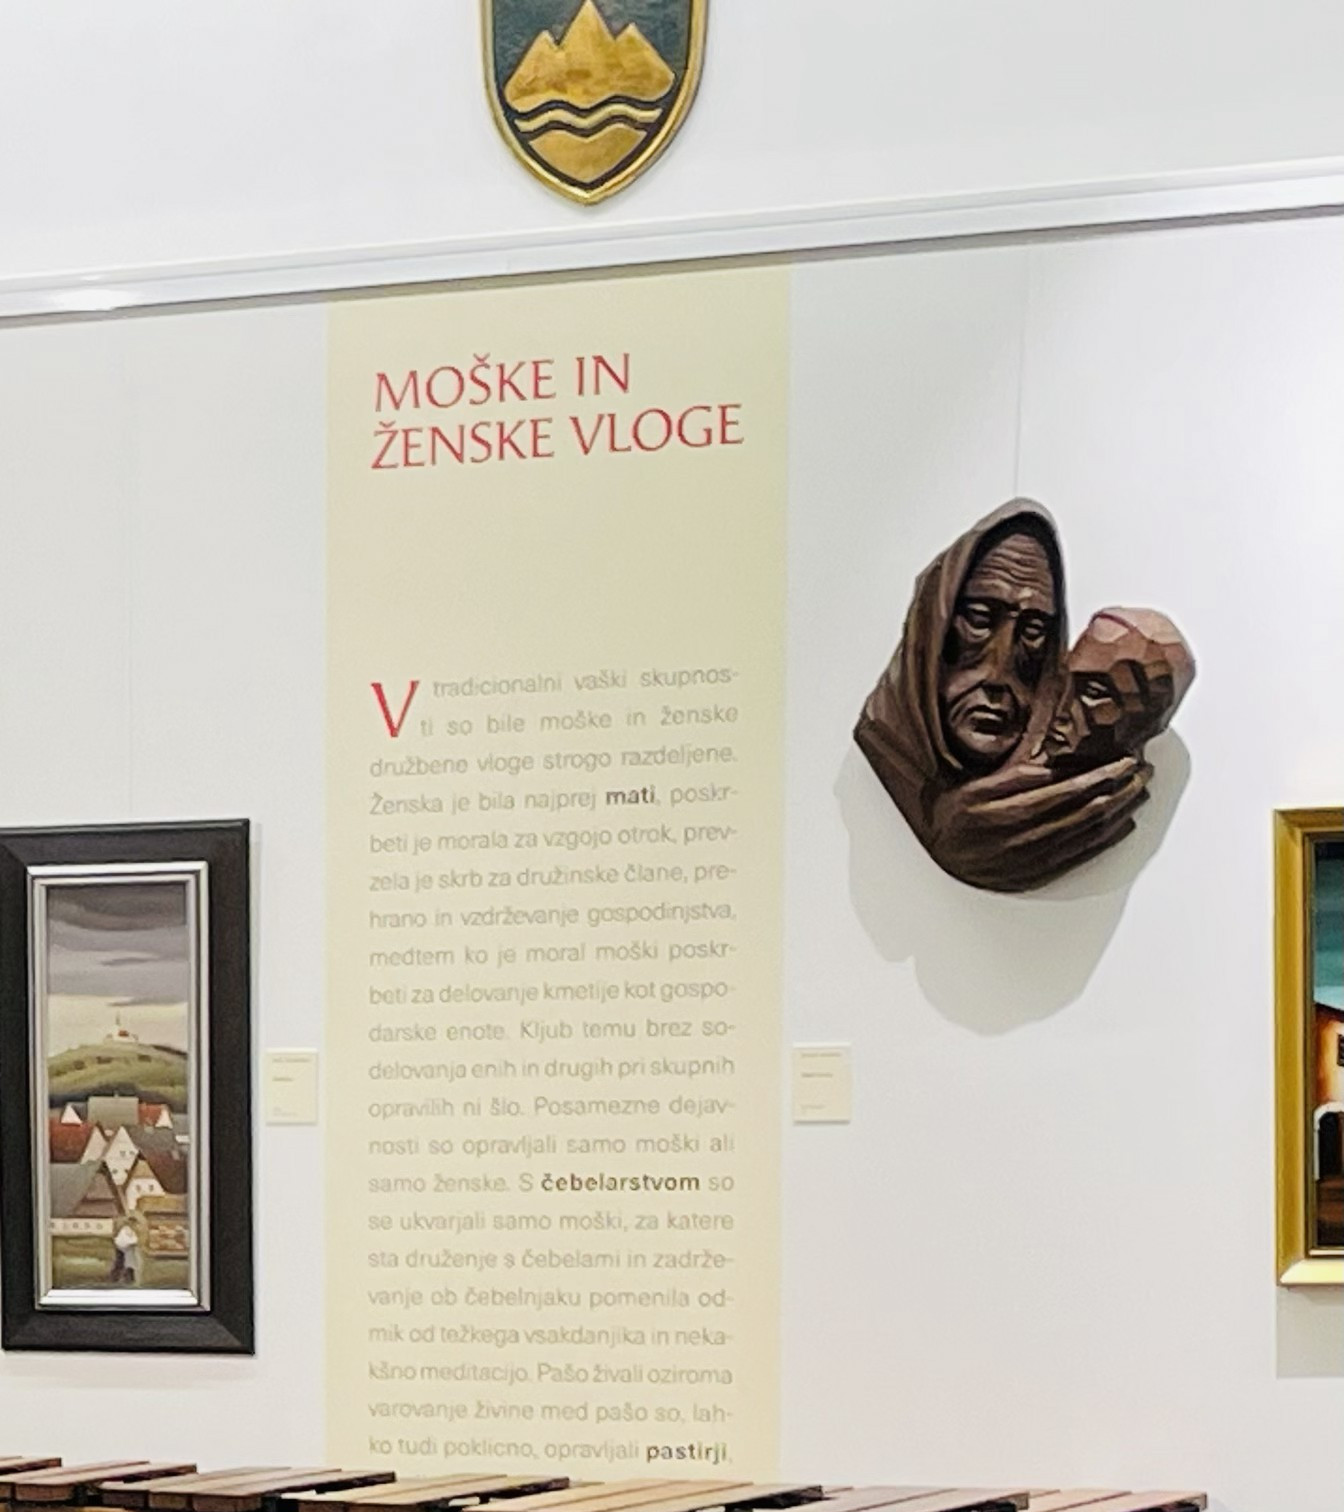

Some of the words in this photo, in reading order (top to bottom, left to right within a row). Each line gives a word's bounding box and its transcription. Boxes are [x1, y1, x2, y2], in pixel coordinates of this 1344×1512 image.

[374, 352, 556, 412] MOŠKE
[575, 352, 630, 396] IN
[370, 419, 555, 469] ŽENSKE
[570, 403, 744, 455] VLOGE
[370, 678, 422, 739] V
[432, 672, 562, 698] tradicionalni
[574, 668, 627, 691] vaški
[640, 667, 739, 690] skupnos-
[420, 717, 433, 737] ti
[447, 719, 473, 737] so
[487, 713, 526, 734] bile
[540, 709, 612, 732] moške
[626, 710, 646, 727] in
[660, 704, 738, 727] ženske
[370, 754, 468, 777] družbene
[477, 752, 534, 776] vloge
[543, 751, 612, 773] strogo
[369, 791, 443, 816] Ženska
[451, 793, 470, 816] je
[479, 791, 515, 811] bila
[525, 789, 596, 813] najprej
[670, 782, 738, 808] poskr-
[370, 833, 408, 854] beti
[412, 835, 432, 857] je
[438, 829, 509, 851] morala
[514, 832, 538, 849] za
[542, 829, 612, 851] vzgojo
[684, 825, 738, 846] prev-
[369, 872, 410, 892] zela
[415, 871, 433, 893] je
[438, 868, 483, 890] skrb
[488, 871, 511, 888] za
[516, 863, 619, 887] družinske
[624, 862, 688, 884] člane,
[694, 864, 737, 885] pre-
[369, 910, 427, 930] hrano
[435, 908, 452, 927] in
[460, 905, 579, 928] vzdrževanje
[369, 946, 455, 967] medtem
[465, 945, 488, 965] ko
[497, 945, 516, 969] je
[526, 941, 586, 963] moral
[595, 940, 658, 961] moški
[669, 939, 736, 964] poskr-
[369, 985, 407, 1005] beti
[411, 988, 434, 1004] za
[439, 983, 539, 1007] delovanje
[543, 980, 619, 1004] kmetije
[624, 980, 656, 1000] kot
[660, 981, 736, 1004] gospo-
[368, 1022, 437, 1043] darske
[520, 1019, 573, 1044] Kljub
[582, 1021, 636, 1039] temu
[646, 1018, 692, 1038] brez
[702, 1020, 736, 1038] so-
[471, 1058, 517, 1079] enih
[522, 1059, 539, 1077] in
[544, 1056, 613, 1083] drugih
[618, 1057, 645, 1080] pri
[650, 1055, 735, 1080] skupnih
[368, 1097, 454, 1121] opravilih
[463, 1096, 481, 1117] ni
[534, 1095, 660, 1117] Posamezne
[669, 1094, 735, 1119] dejav-
[369, 1138, 419, 1156] nosti
[428, 1139, 453, 1156] so
[462, 1133, 556, 1159] opravljali
[567, 1137, 626, 1154] samo
[636, 1133, 700, 1154] moški
[710, 1133, 735, 1154] ali
[369, 1178, 425, 1193] samo
[519, 1172, 533, 1192] S
[541, 1172, 700, 1192] čebelarstvom
[709, 1175, 734, 1192] so
[368, 1215, 393, 1231] se
[400, 1211, 485, 1235] ukvarjali
[493, 1214, 552, 1231] samo
[559, 1210, 628, 1233] moški,
[634, 1214, 659, 1231] za
[667, 1210, 734, 1231] katere
[368, 1250, 399, 1269] sta
[405, 1248, 498, 1273] druženje
[503, 1252, 515, 1270] s
[522, 1248, 620, 1269] čebelami
[627, 1249, 646, 1268] in
[653, 1248, 734, 1269] zadrže-
[368, 1286, 423, 1310] vanje
[431, 1285, 458, 1307] ob
[464, 1286, 581, 1312] čebelnjaku
[590, 1286, 690, 1311] pomenila
[698, 1288, 734, 1309] od-
[368, 1324, 404, 1343] mik
[409, 1324, 436, 1344] od
[440, 1323, 520, 1349] težkega
[651, 1326, 669, 1346] in
[675, 1326, 733, 1346] neka-
[537, 1361, 589, 1384] Pašo
[592, 1363, 643, 1383] živali
[647, 1364, 733, 1385] oziroma
[368, 1402, 468, 1423] varovanje
[474, 1399, 534, 1421] živine
[541, 1400, 588, 1422] med
[596, 1401, 648, 1425] pašo
[693, 1402, 733, 1423] lah-
[369, 1435, 393, 1455] ko
[398, 1435, 438, 1457] tudi
[544, 1439, 639, 1464] opravljali
